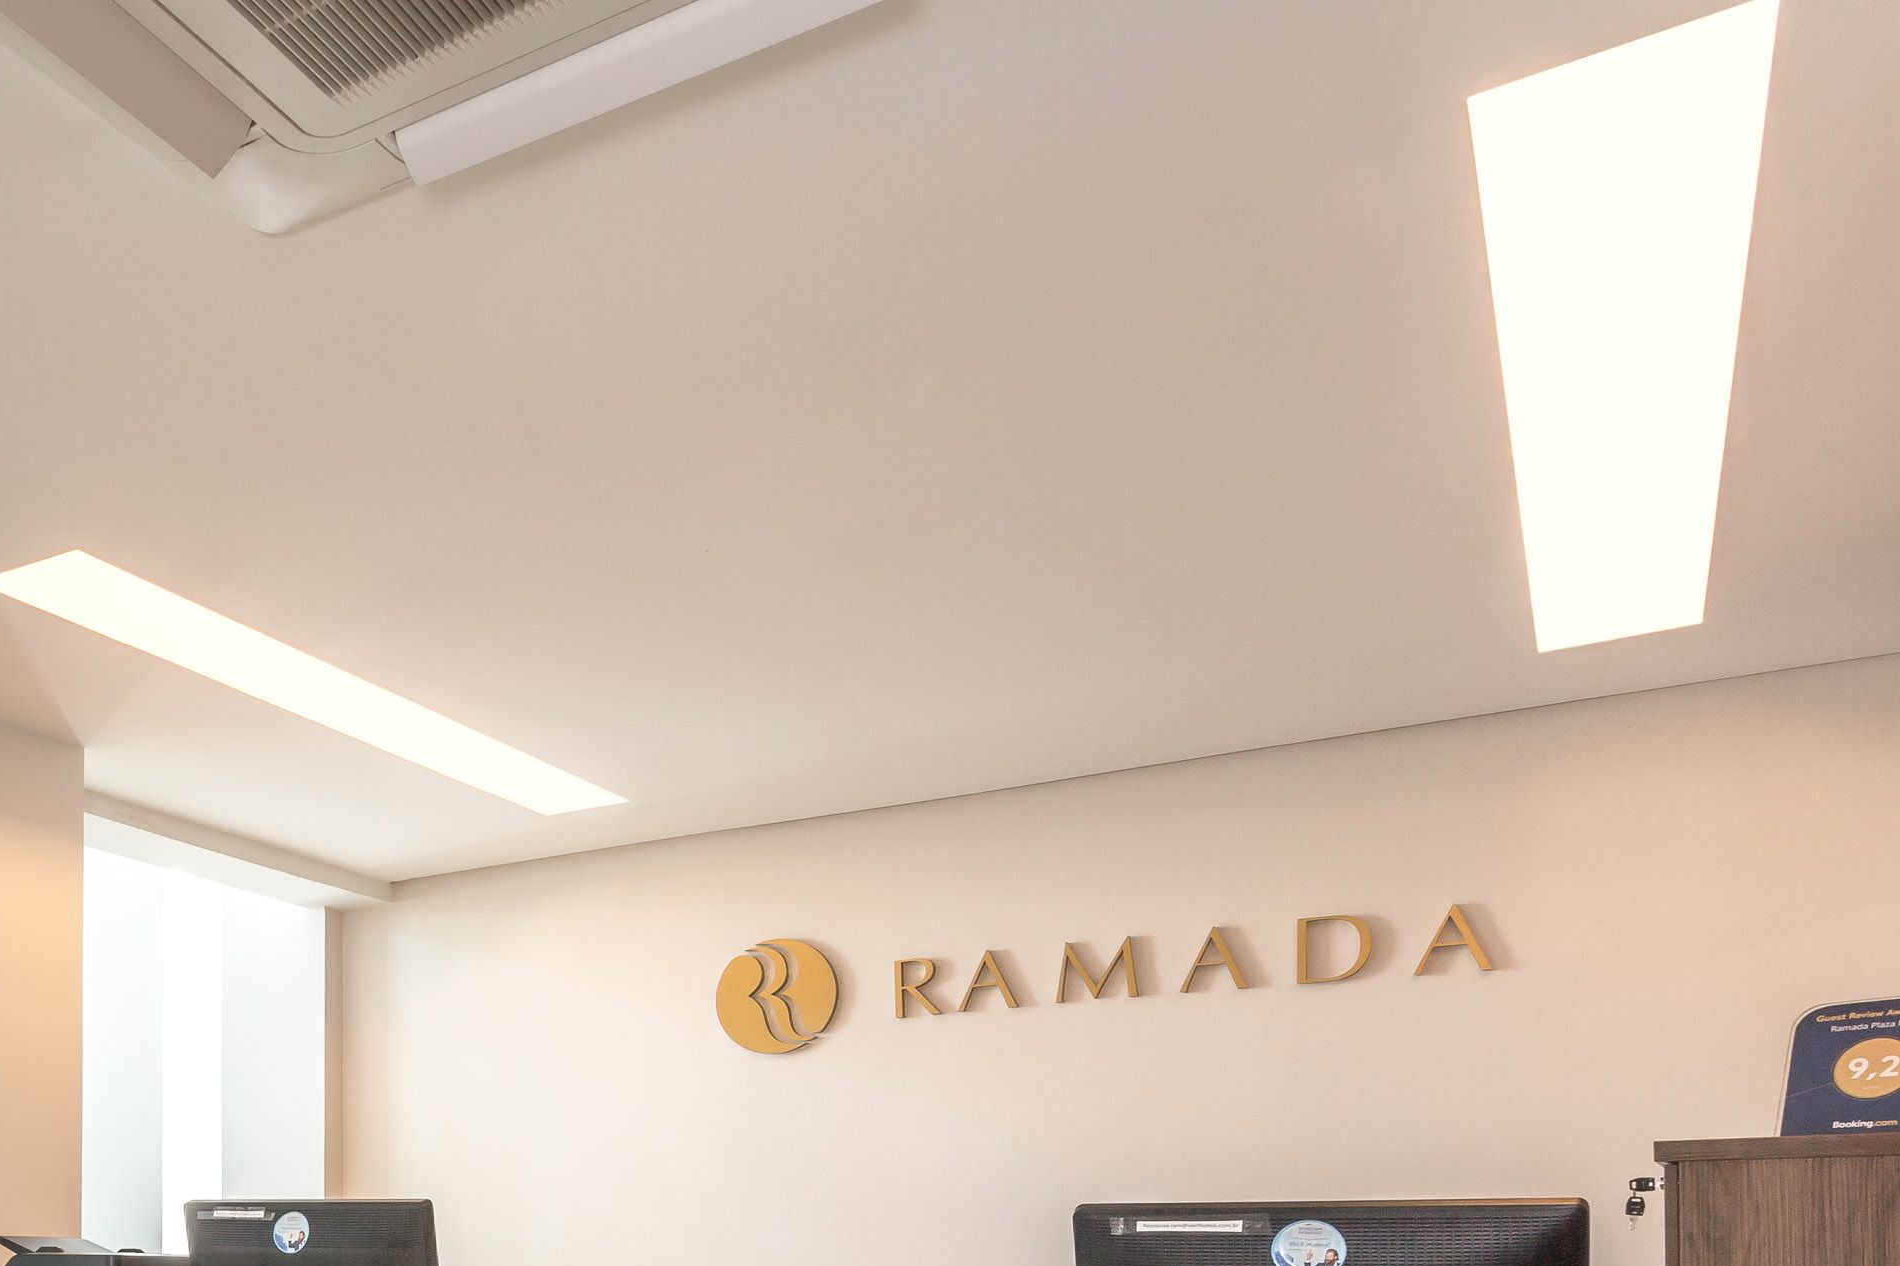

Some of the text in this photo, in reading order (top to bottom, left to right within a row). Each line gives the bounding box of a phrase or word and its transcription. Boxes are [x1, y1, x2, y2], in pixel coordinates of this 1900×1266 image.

[893, 903, 1496, 1020] RAMADA
[1816, 1014, 1847, 1022] Guest
[1848, 1010, 1884, 1020] Review
[1830, 1022, 1869, 1033] Ramada
[1870, 1020, 1896, 1030] Plaza
[1847, 1054, 1900, 1081] 9,2
[1831, 1119, 1898, 1130] Booking.com
